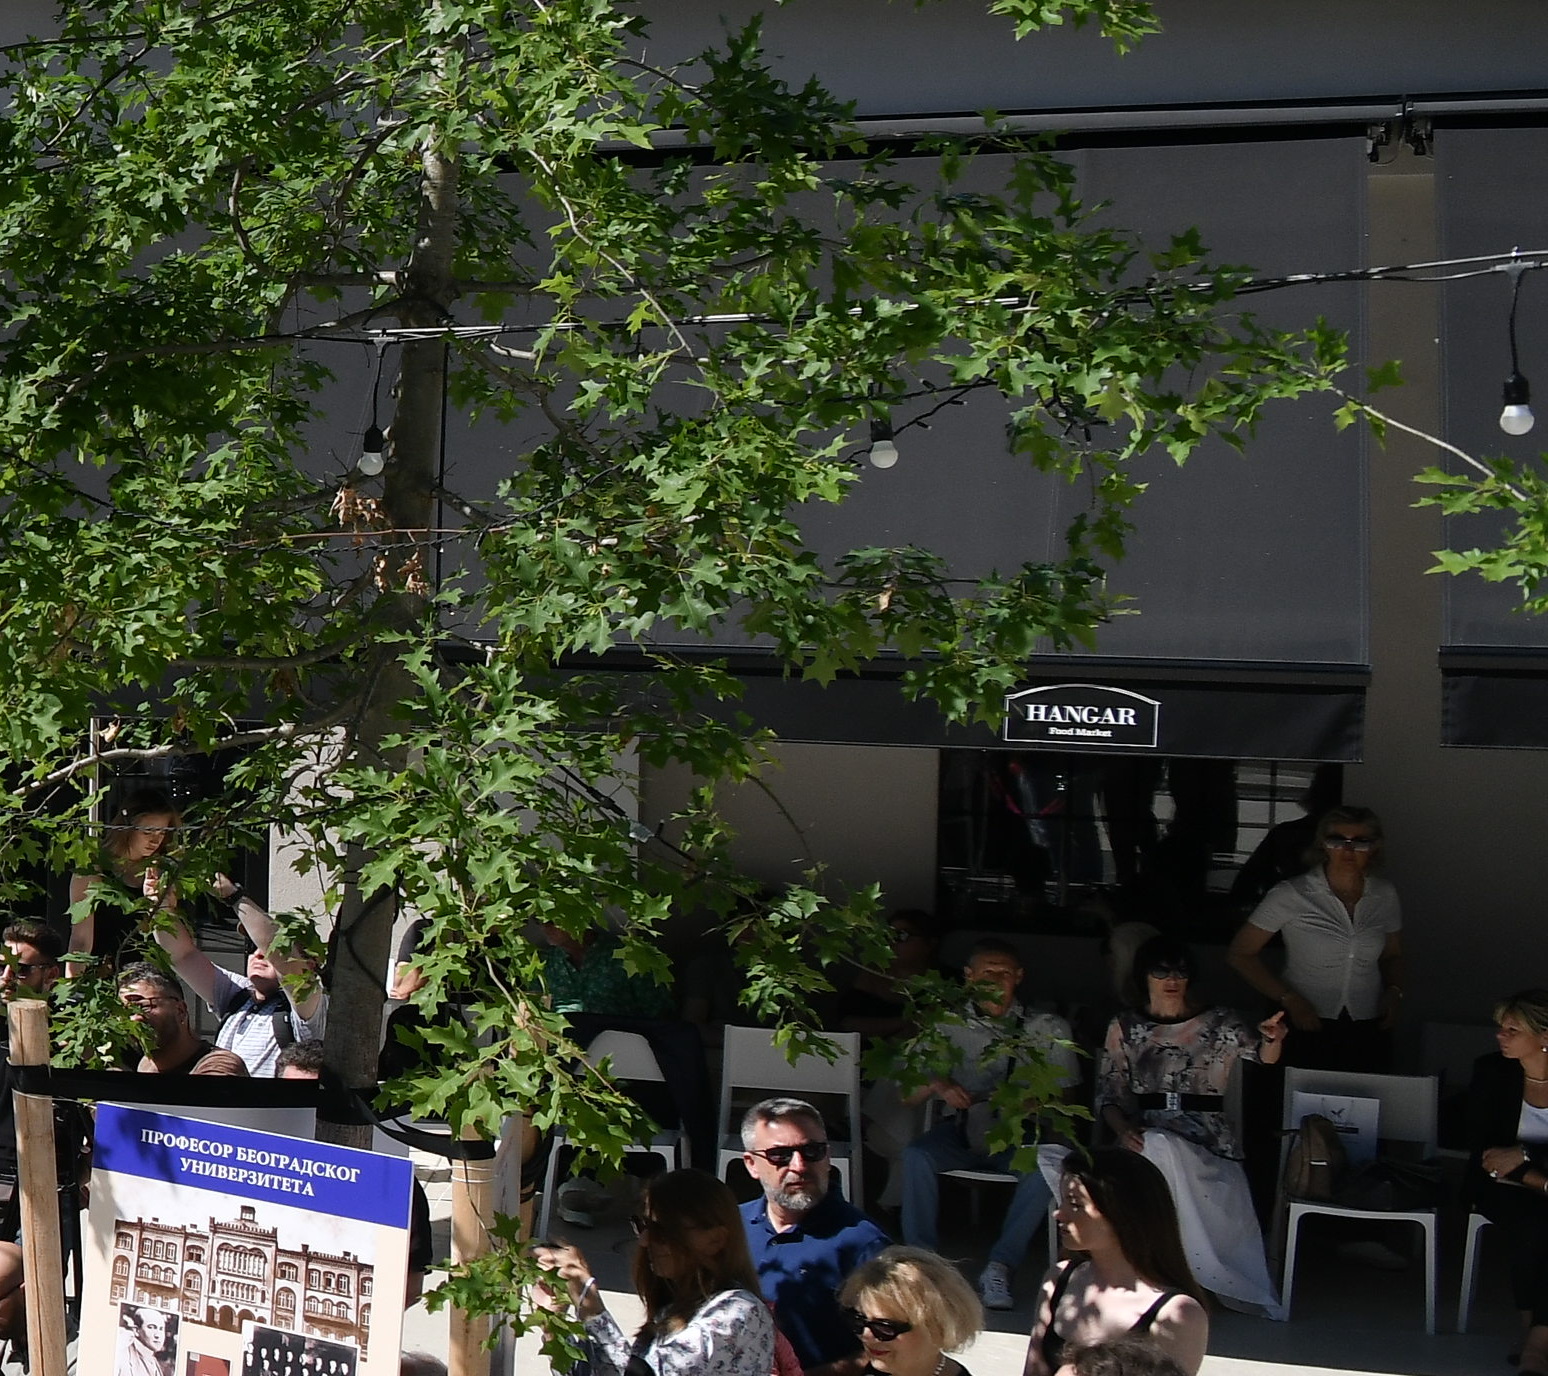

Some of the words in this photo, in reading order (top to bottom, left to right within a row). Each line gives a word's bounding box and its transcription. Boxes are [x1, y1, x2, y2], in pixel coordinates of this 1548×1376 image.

[1025, 703, 1138, 726] HANGAR
[1048, 726, 1074, 736] Food
[1075, 727, 1113, 737] Market
[141, 1128, 234, 1160] ПРОФЕСОР
[236, 1146, 361, 1184] БЕОГРАДСКОГ
[180, 1157, 316, 1197] УНИВЕРЗИТЕТА
